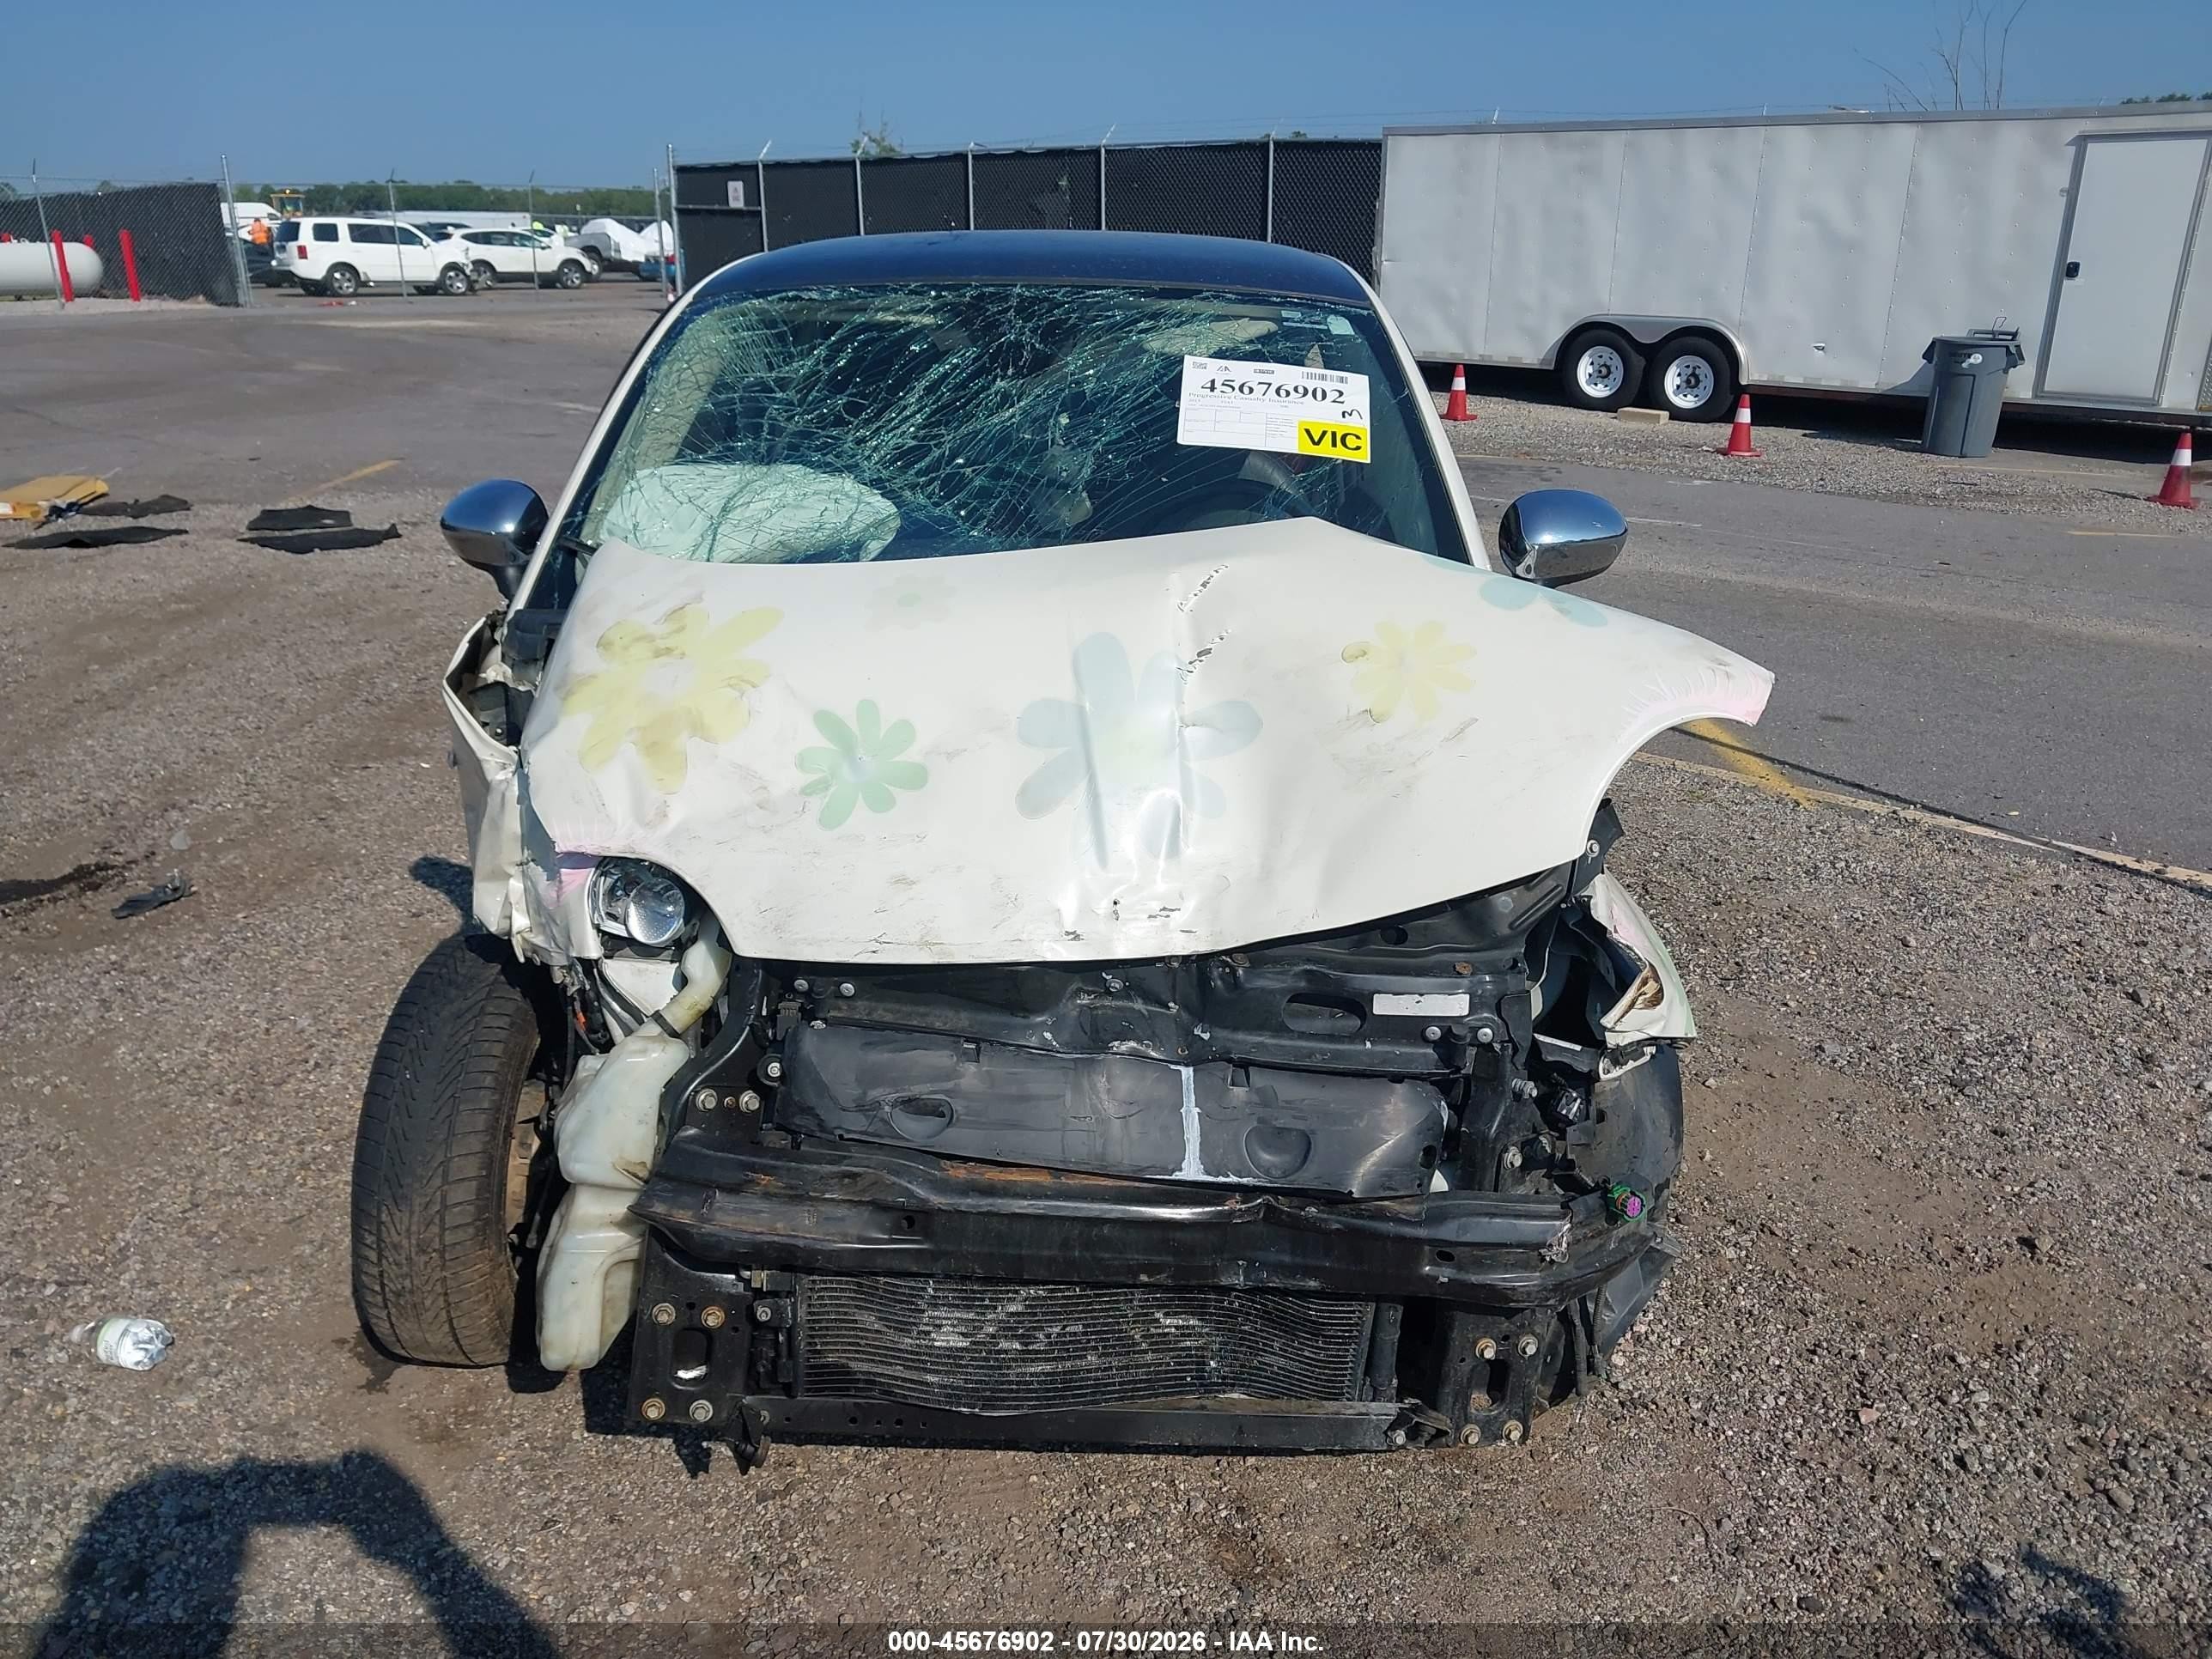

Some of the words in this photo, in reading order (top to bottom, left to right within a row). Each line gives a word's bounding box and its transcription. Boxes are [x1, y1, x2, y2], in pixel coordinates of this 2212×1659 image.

[1188, 392, 1232, 400] Progressive
[1200, 378, 1346, 404] 45676902
[1304, 428, 1363, 452] VIC
